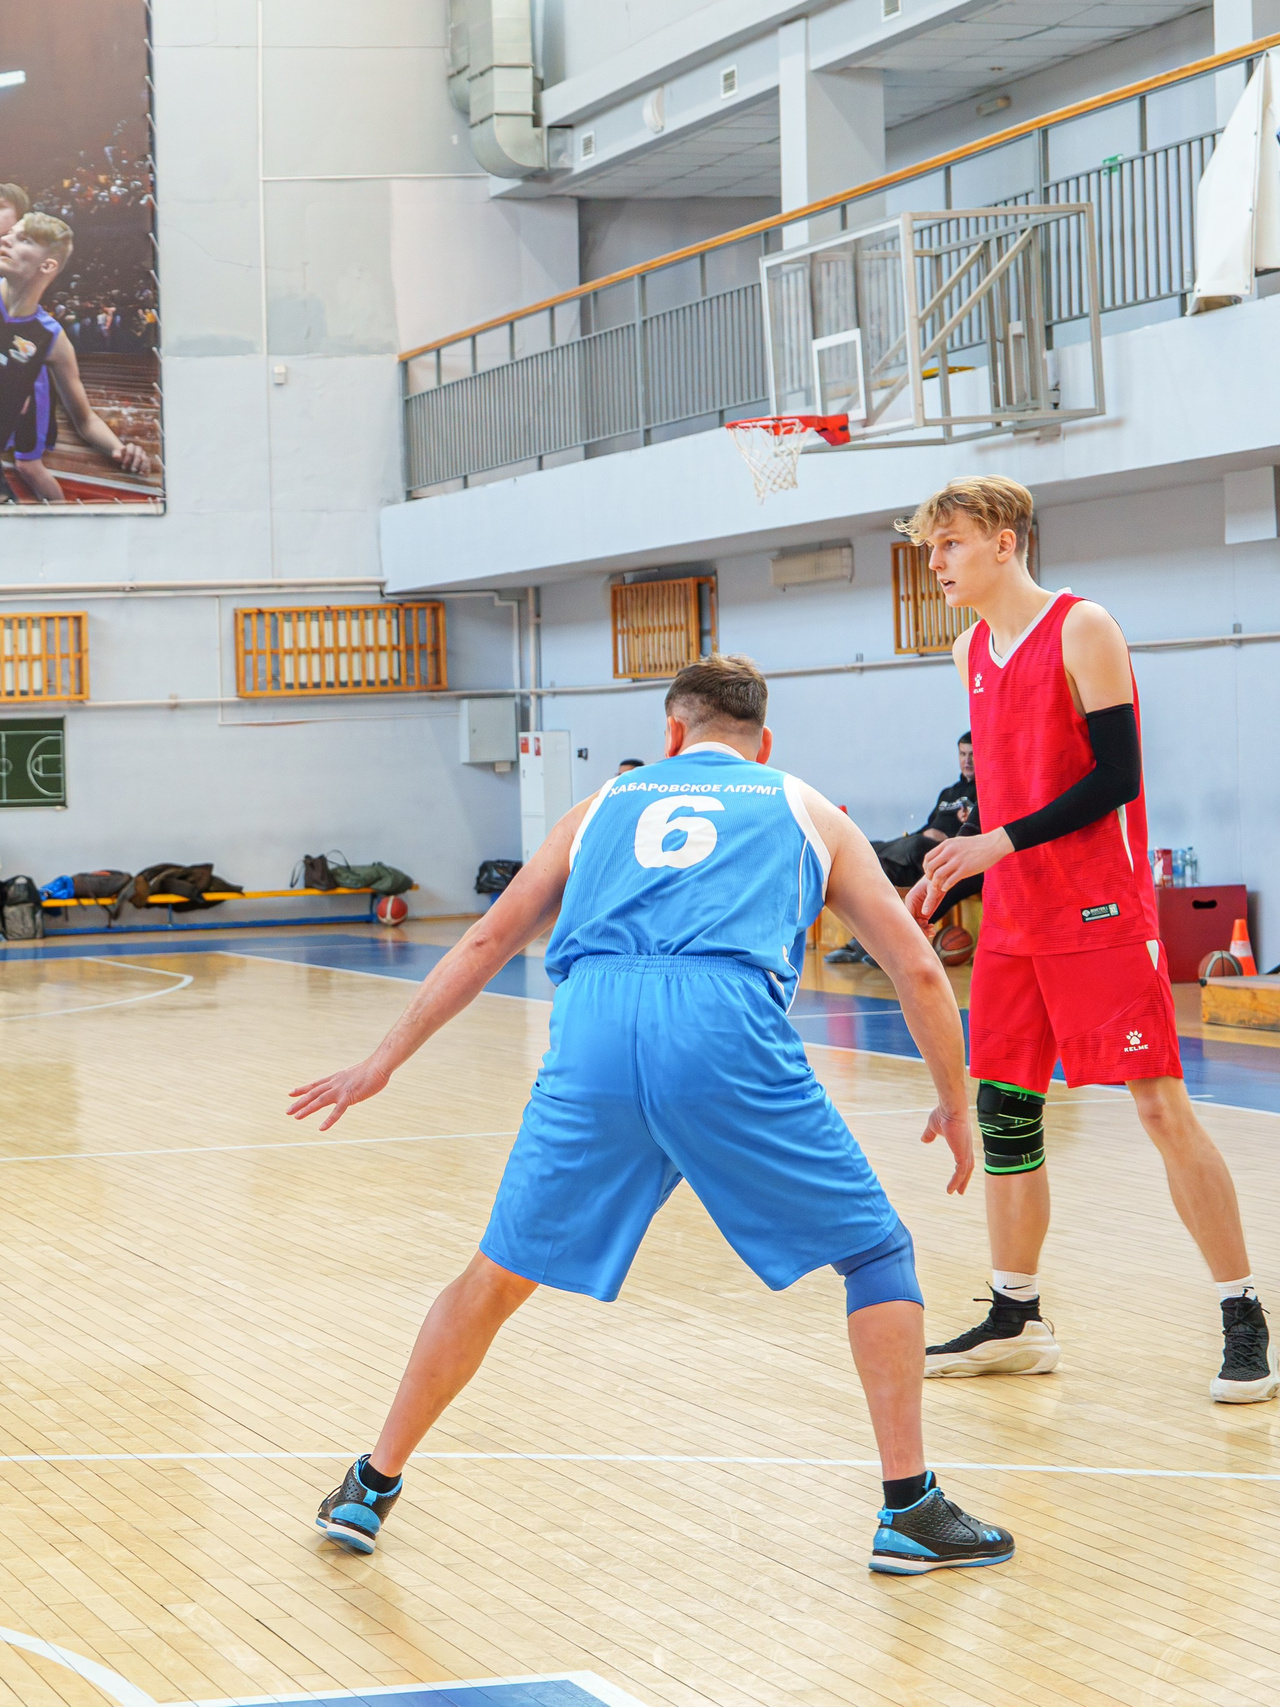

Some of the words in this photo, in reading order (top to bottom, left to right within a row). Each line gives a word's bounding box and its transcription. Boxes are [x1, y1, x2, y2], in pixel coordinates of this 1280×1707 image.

[608, 782, 723, 798] ХАБАРОВСКОЕ
[723, 785, 783, 796] ЛПУМГ
[634, 794, 726, 869] 6
[1123, 1043, 1149, 1052] KELME
